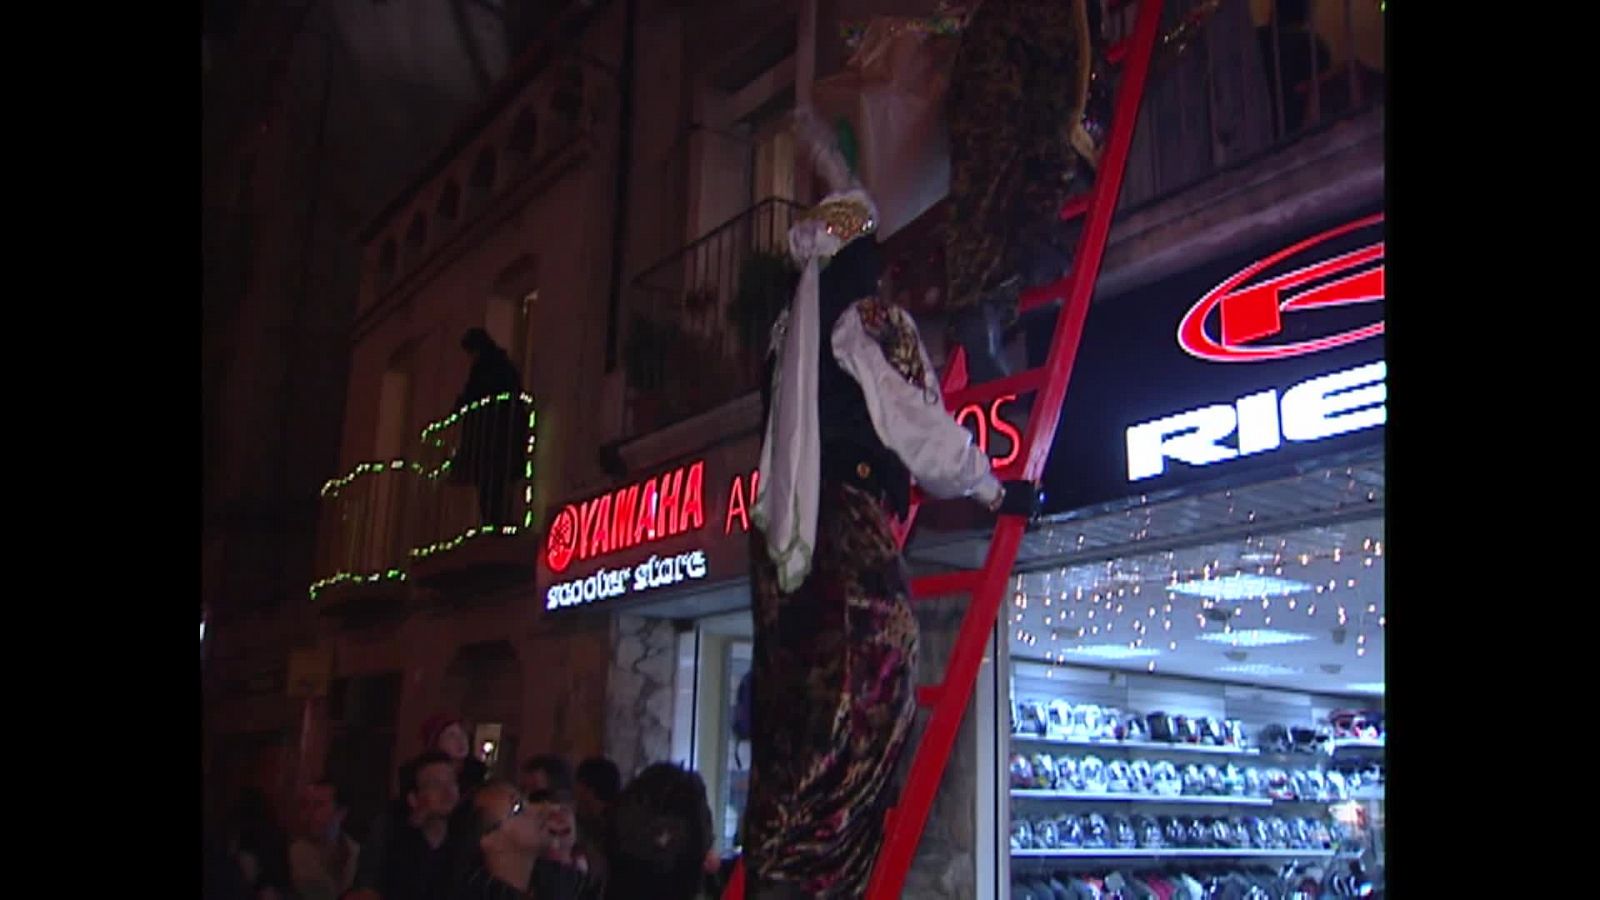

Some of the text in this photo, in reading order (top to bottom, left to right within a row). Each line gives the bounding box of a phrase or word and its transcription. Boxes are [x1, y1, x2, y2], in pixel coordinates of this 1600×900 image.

[578, 460, 705, 559] YAMAHA
[546, 549, 707, 609] scooter store
